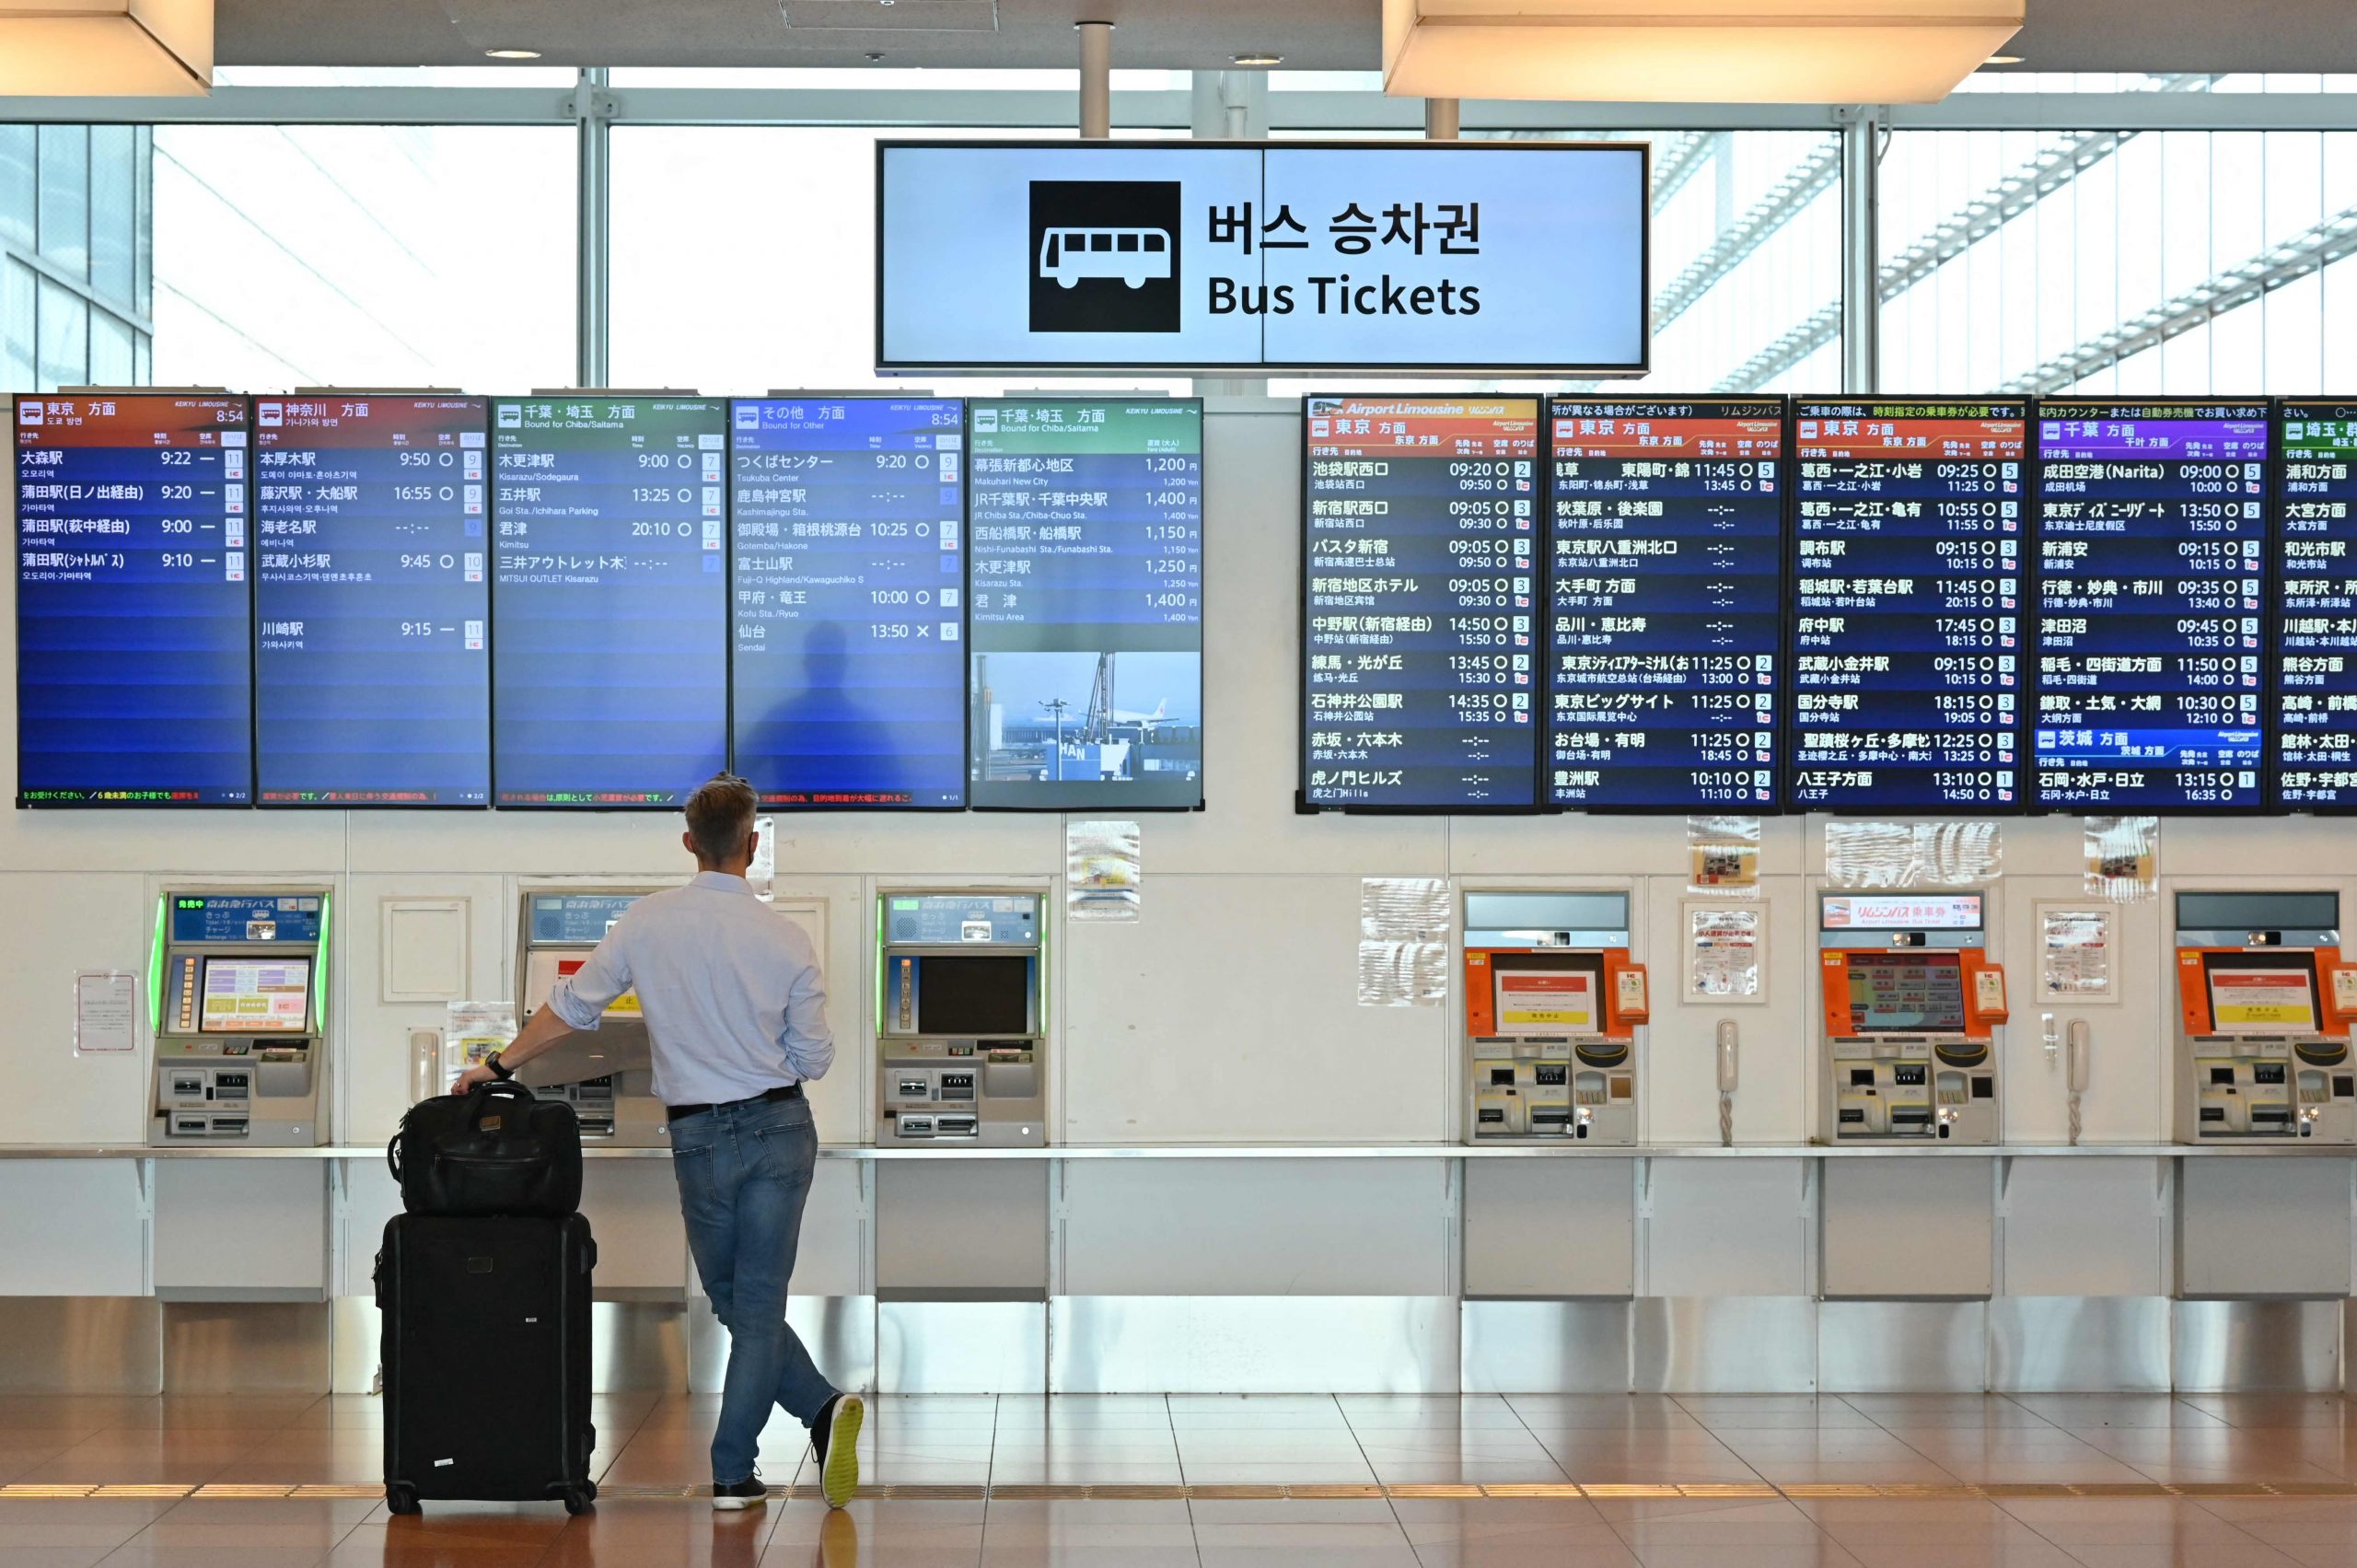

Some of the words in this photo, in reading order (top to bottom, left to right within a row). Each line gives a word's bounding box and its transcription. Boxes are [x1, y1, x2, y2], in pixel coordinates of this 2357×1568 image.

[1209, 202, 1310, 255] 버스
[1329, 200, 1480, 257] 승차권
[1210, 276, 1295, 316] Bus
[1310, 274, 1481, 316] Tickets
[47, 402, 75, 415] 東京
[88, 402, 115, 415] 方面
[285, 403, 327, 416] 神奈川
[342, 403, 368, 416] 方面
[609, 405, 634, 419] 方面
[763, 407, 803, 420] その他
[819, 407, 844, 420] 方面
[1346, 403, 1394, 414] Airport
[1397, 403, 1463, 414] Limousine
[67, 417, 82, 425] 방면
[216, 411, 243, 422] 8:54
[285, 418, 319, 426] 가나가와
[322, 418, 338, 426] 방면
[1078, 410, 1105, 423] 方面
[565, 421, 623, 429] Chiba/Saitama
[1336, 420, 1370, 434] 東京
[1379, 423, 1406, 434] 方面
[1580, 420, 1614, 434] 東京
[1623, 423, 1650, 434] 方面
[1824, 421, 1858, 436] 東京
[1867, 424, 1894, 435] 方面
[2064, 422, 2098, 436] 千葉
[2107, 424, 2134, 436] 方面
[1395, 436, 1414, 445] 东京
[1419, 436, 1438, 445] 方面
[21, 451, 63, 464] 大森駅
[161, 452, 191, 464] 9:22
[261, 453, 315, 466] 本厚木駅
[401, 453, 430, 465] 9:50
[500, 454, 554, 468] 木更津駅
[639, 455, 668, 468] 9:00
[738, 456, 832, 469] つくばセンター
[877, 456, 906, 469] 9:20
[975, 459, 1074, 472] 幕張新都心地区
[1146, 459, 1185, 471] 1,200
[1313, 462, 1388, 476] 池袋駅西口
[1450, 463, 1491, 476] 09:20
[1519, 464, 1526, 475] 2
[1695, 463, 1735, 476] 11:45
[1763, 465, 1770, 476] 5
[2180, 466, 2221, 478] 09:00
[2286, 465, 2347, 479] 浦和方面
[22, 470, 54, 478] 오모리역
[500, 473, 578, 482] Kisarazu/Sodegaura
[1033, 478, 1048, 486] City
[1315, 480, 1364, 489] 池袋站西口
[1460, 481, 1492, 489] 09:50
[2045, 482, 2085, 492] 成田机场
[2190, 482, 2221, 492] 10:00
[162, 486, 192, 498] 9:20
[500, 488, 540, 501] 五井駅
[633, 489, 669, 502] 13:25
[737, 490, 806, 503] 鹿島神宮駅
[22, 504, 54, 512] 가마타역
[1313, 501, 1387, 515] 新宿駅西口
[1450, 502, 1491, 515] 09:05
[2286, 504, 2346, 517] 大宮方面
[162, 520, 192, 532] 9:00
[261, 520, 316, 534] 海老名駅
[500, 522, 527, 535] 君津
[633, 523, 669, 535] 20:10
[872, 524, 908, 536] 10:25
[1146, 527, 1185, 540] 1,150
[737, 542, 807, 551] Gotemba/Hakone
[1313, 540, 1387, 553] バスタ新宿
[1449, 540, 1490, 552] 09:05
[1557, 540, 1677, 554] 東京駅八重洲北口
[1800, 540, 1845, 555] 調布駅
[1936, 541, 1977, 554] 09:15
[2042, 541, 2087, 556] 新浦安
[2178, 542, 2220, 555] 09:15
[2285, 541, 2345, 556] 和光市駅
[261, 554, 331, 567] 武蔵小杉駅
[401, 555, 430, 567] 9:45
[738, 557, 792, 570] 富士山駅
[975, 561, 1030, 574] 木更津駅
[1146, 561, 1185, 574] 1,250
[1313, 578, 1418, 592] 新宿地区ホテル
[1556, 578, 1601, 593] 大手町
[1606, 578, 1635, 593] 方面
[872, 592, 909, 604] 10:00
[1146, 594, 1185, 607] 1,400
[262, 621, 303, 635] 川崎駅
[402, 623, 431, 635] 9:15
[739, 625, 765, 638] 仙台
[872, 625, 909, 638] 13:50
[1799, 618, 1844, 633] 府中駅
[1936, 619, 1976, 632] 17:45
[2041, 619, 2086, 633] 津田沼
[2177, 620, 2218, 633] 09:45
[262, 641, 303, 649] 가와사키역
[1798, 656, 1888, 671] 武蔵小金井駅
[1934, 657, 1975, 670] 09:15
[2283, 657, 2343, 671] 熊谷方面
[1312, 693, 1402, 708] 石神井公園駅
[1449, 695, 1489, 707] 14:35
[1555, 694, 1673, 709] 東京ビッグサイト
[1692, 695, 1732, 708] 11:25
[1798, 695, 1858, 709] 国分寺駅
[1935, 696, 1975, 709] 18:15
[1691, 734, 1731, 747] 11:25
[2060, 730, 2092, 745] 茨城
[2100, 733, 2128, 745] 方面
[1311, 771, 1402, 785] 虎ノ門ヒルズ
[1554, 772, 1599, 785] 豊洲駅
[1691, 772, 1731, 784] 10:10
[1797, 772, 1872, 786] 八王子方面
[1933, 772, 1973, 785] 13:10
[2176, 773, 2215, 786] 13:15
[1555, 789, 1585, 798] 丰洲站
[1701, 789, 1731, 798] 11:10
[1913, 907, 1945, 916] 乗車券
